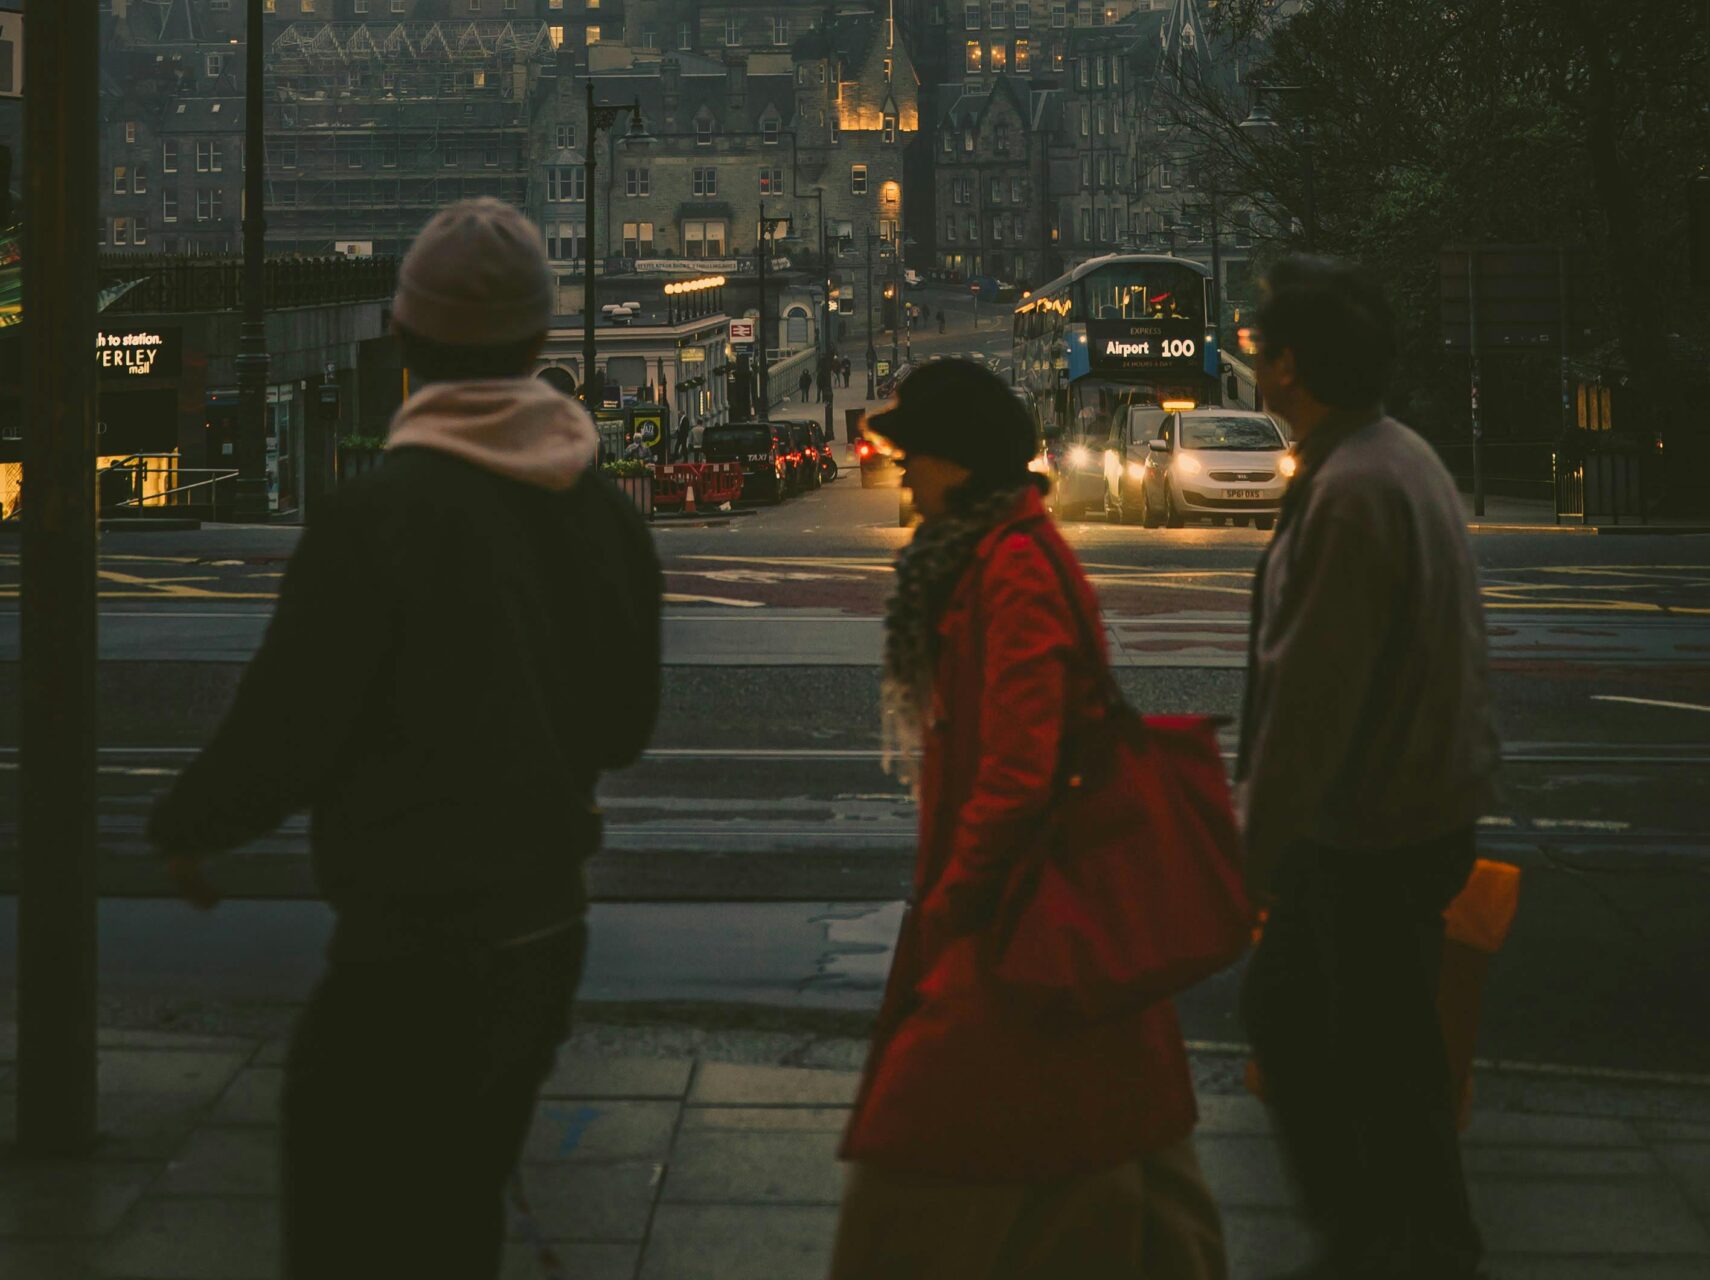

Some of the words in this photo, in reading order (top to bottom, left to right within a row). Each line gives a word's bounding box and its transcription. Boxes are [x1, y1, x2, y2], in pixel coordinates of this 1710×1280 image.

[1130, 327, 1162, 335] EXPRESS
[107, 333, 121, 347] to
[122, 332, 163, 346] station.
[1106, 340, 1149, 357] Airport
[1161, 339, 1195, 357] 100
[128, 361, 150, 374] mall
[747, 453, 767, 462] TAXI
